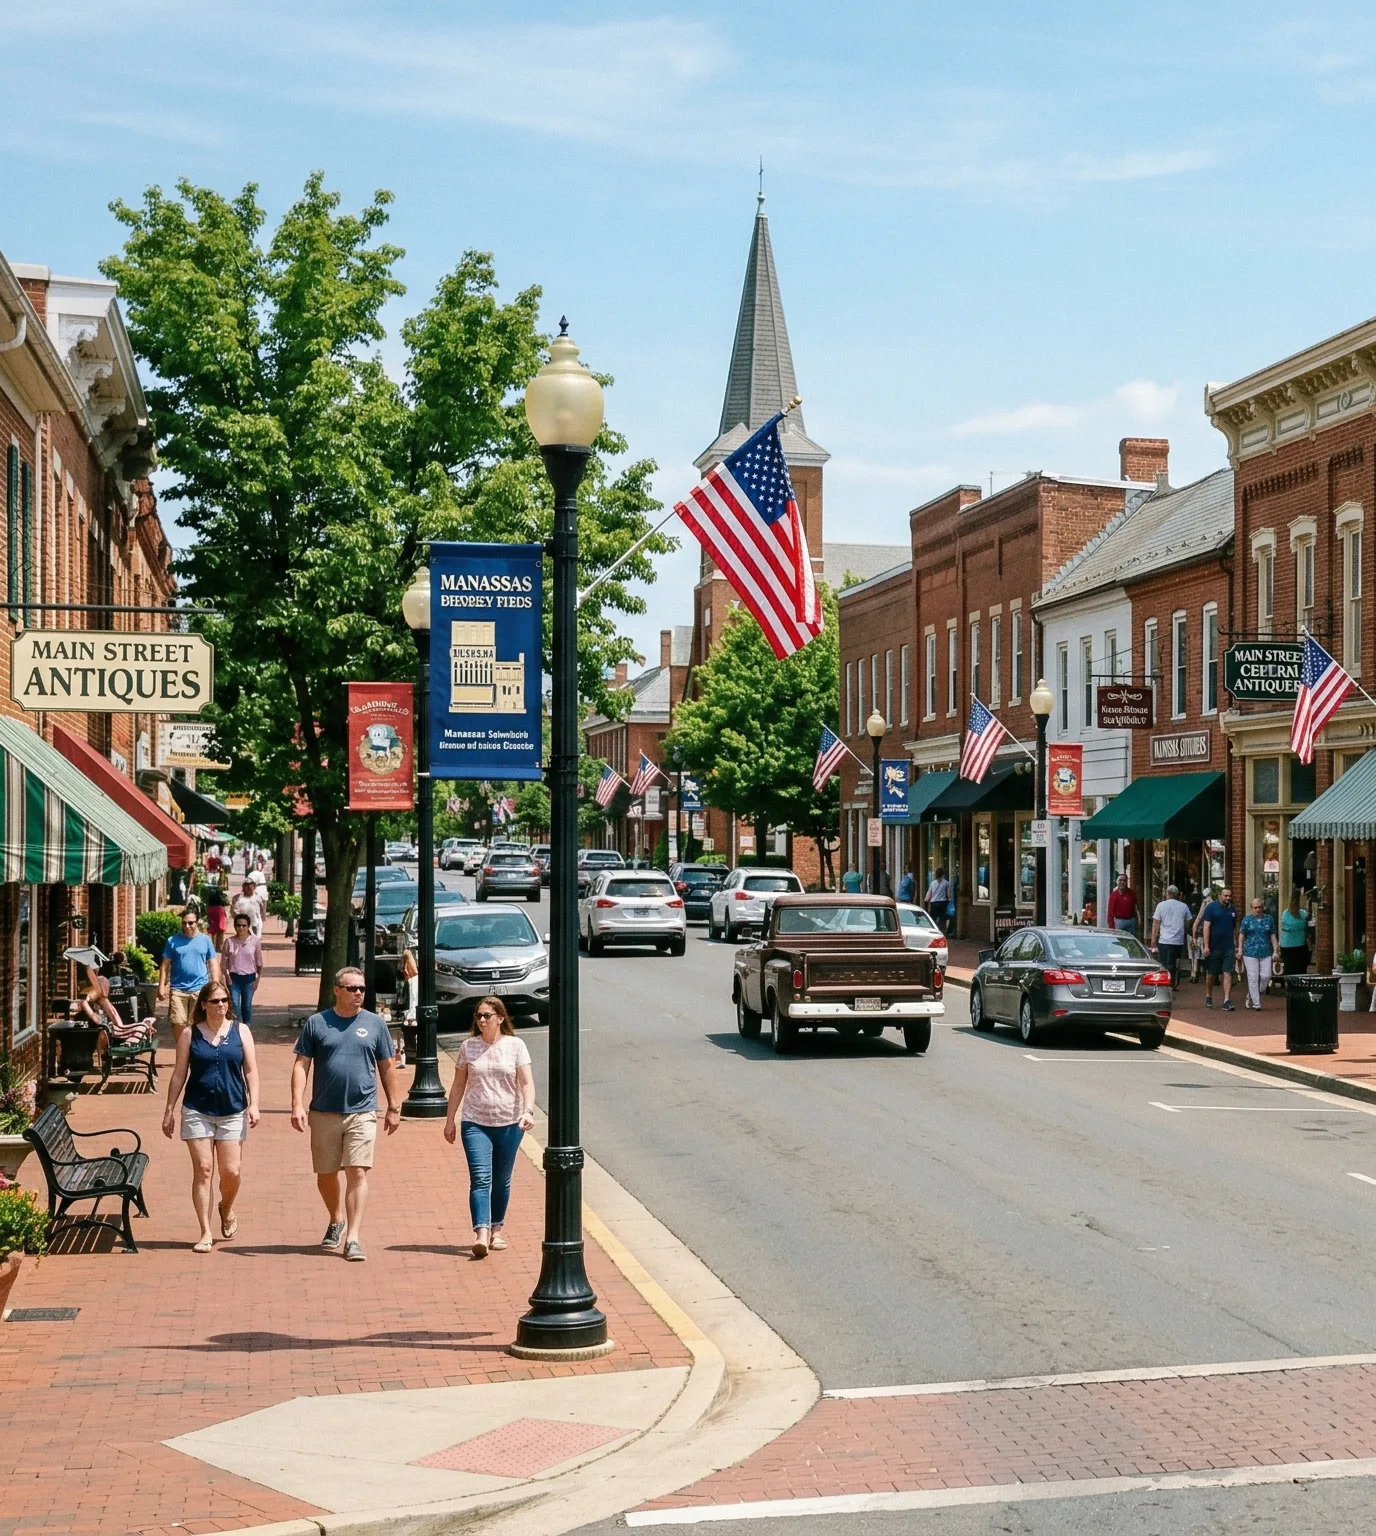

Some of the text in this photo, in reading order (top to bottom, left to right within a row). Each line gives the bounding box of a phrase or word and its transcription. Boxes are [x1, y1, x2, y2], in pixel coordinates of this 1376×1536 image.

[440, 574, 533, 592] MANASSAS
[31, 640, 194, 664] MAIN STREET
[1234, 649, 1263, 663] MAIN
[23, 666, 201, 706] ANTIQUES
